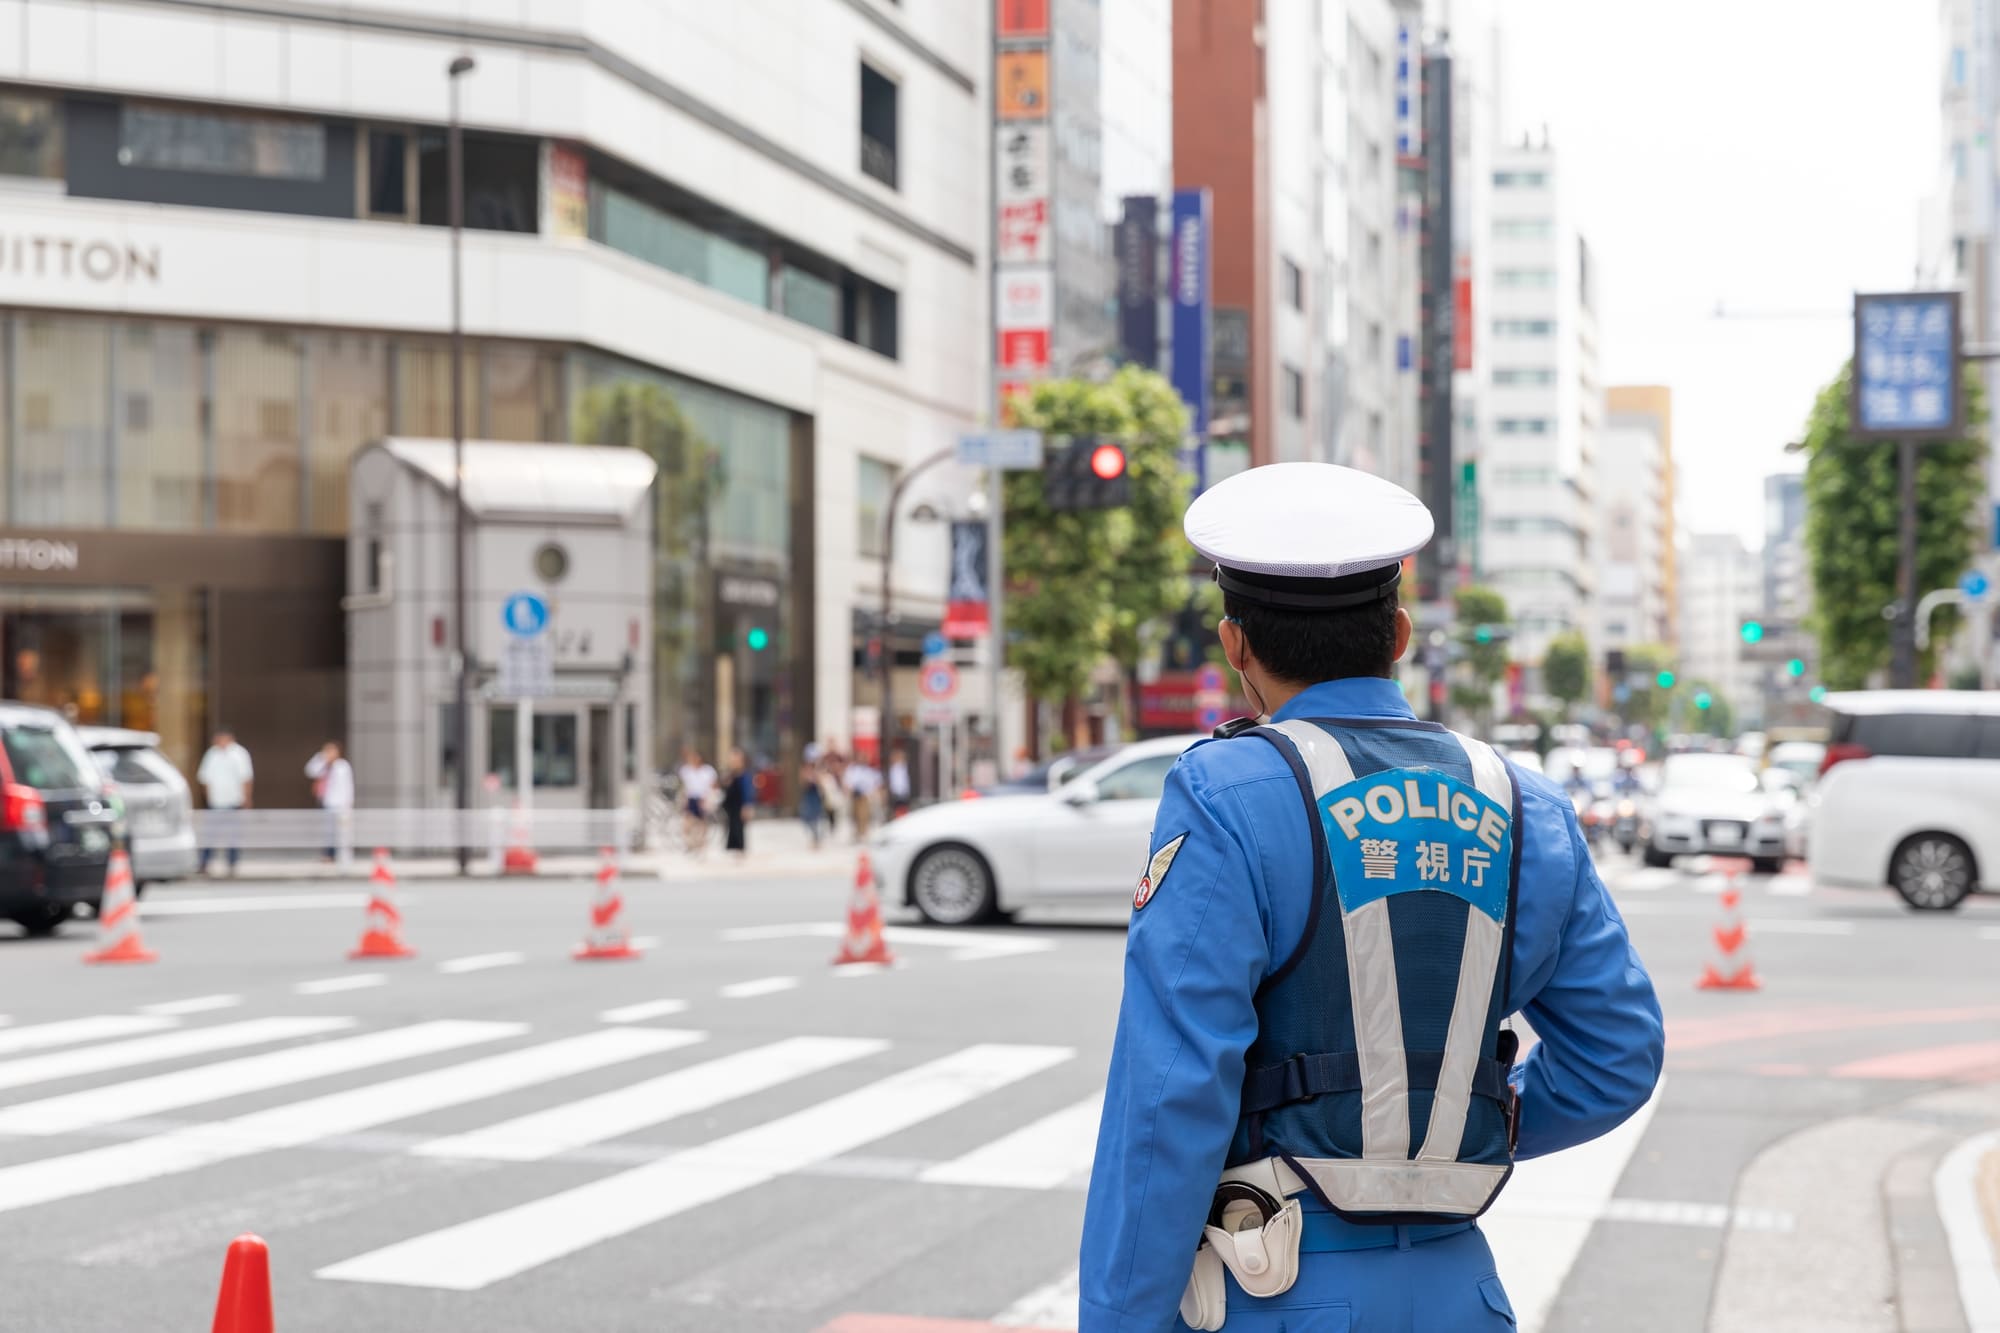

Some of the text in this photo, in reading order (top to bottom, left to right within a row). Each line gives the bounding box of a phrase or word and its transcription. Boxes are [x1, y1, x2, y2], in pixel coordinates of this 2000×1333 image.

[0, 234, 161, 284] ITTON
[1329, 780, 1508, 853] POLICE
[1360, 838, 1491, 888] 警視庁
